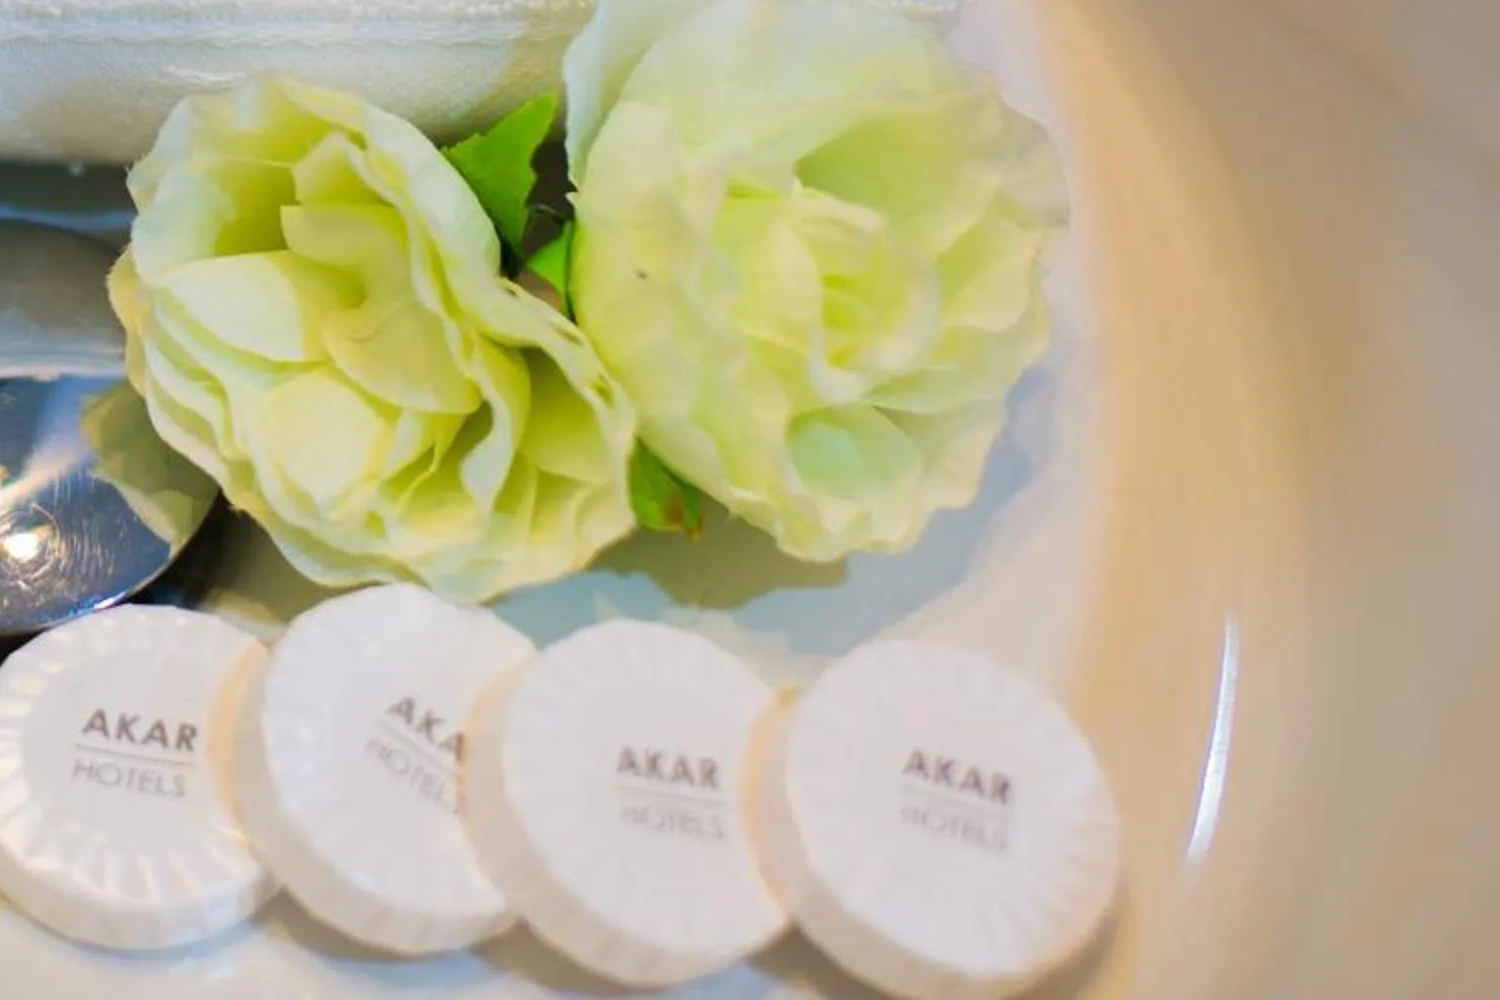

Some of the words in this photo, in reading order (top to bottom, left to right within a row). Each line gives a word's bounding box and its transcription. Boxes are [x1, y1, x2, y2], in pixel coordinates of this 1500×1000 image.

[82, 709, 199, 754] AKAR
[385, 697, 467, 764] AKA
[72, 758, 188, 800] HOTELS
[616, 746, 720, 790] AKAR
[901, 748, 1011, 806] AKAR
